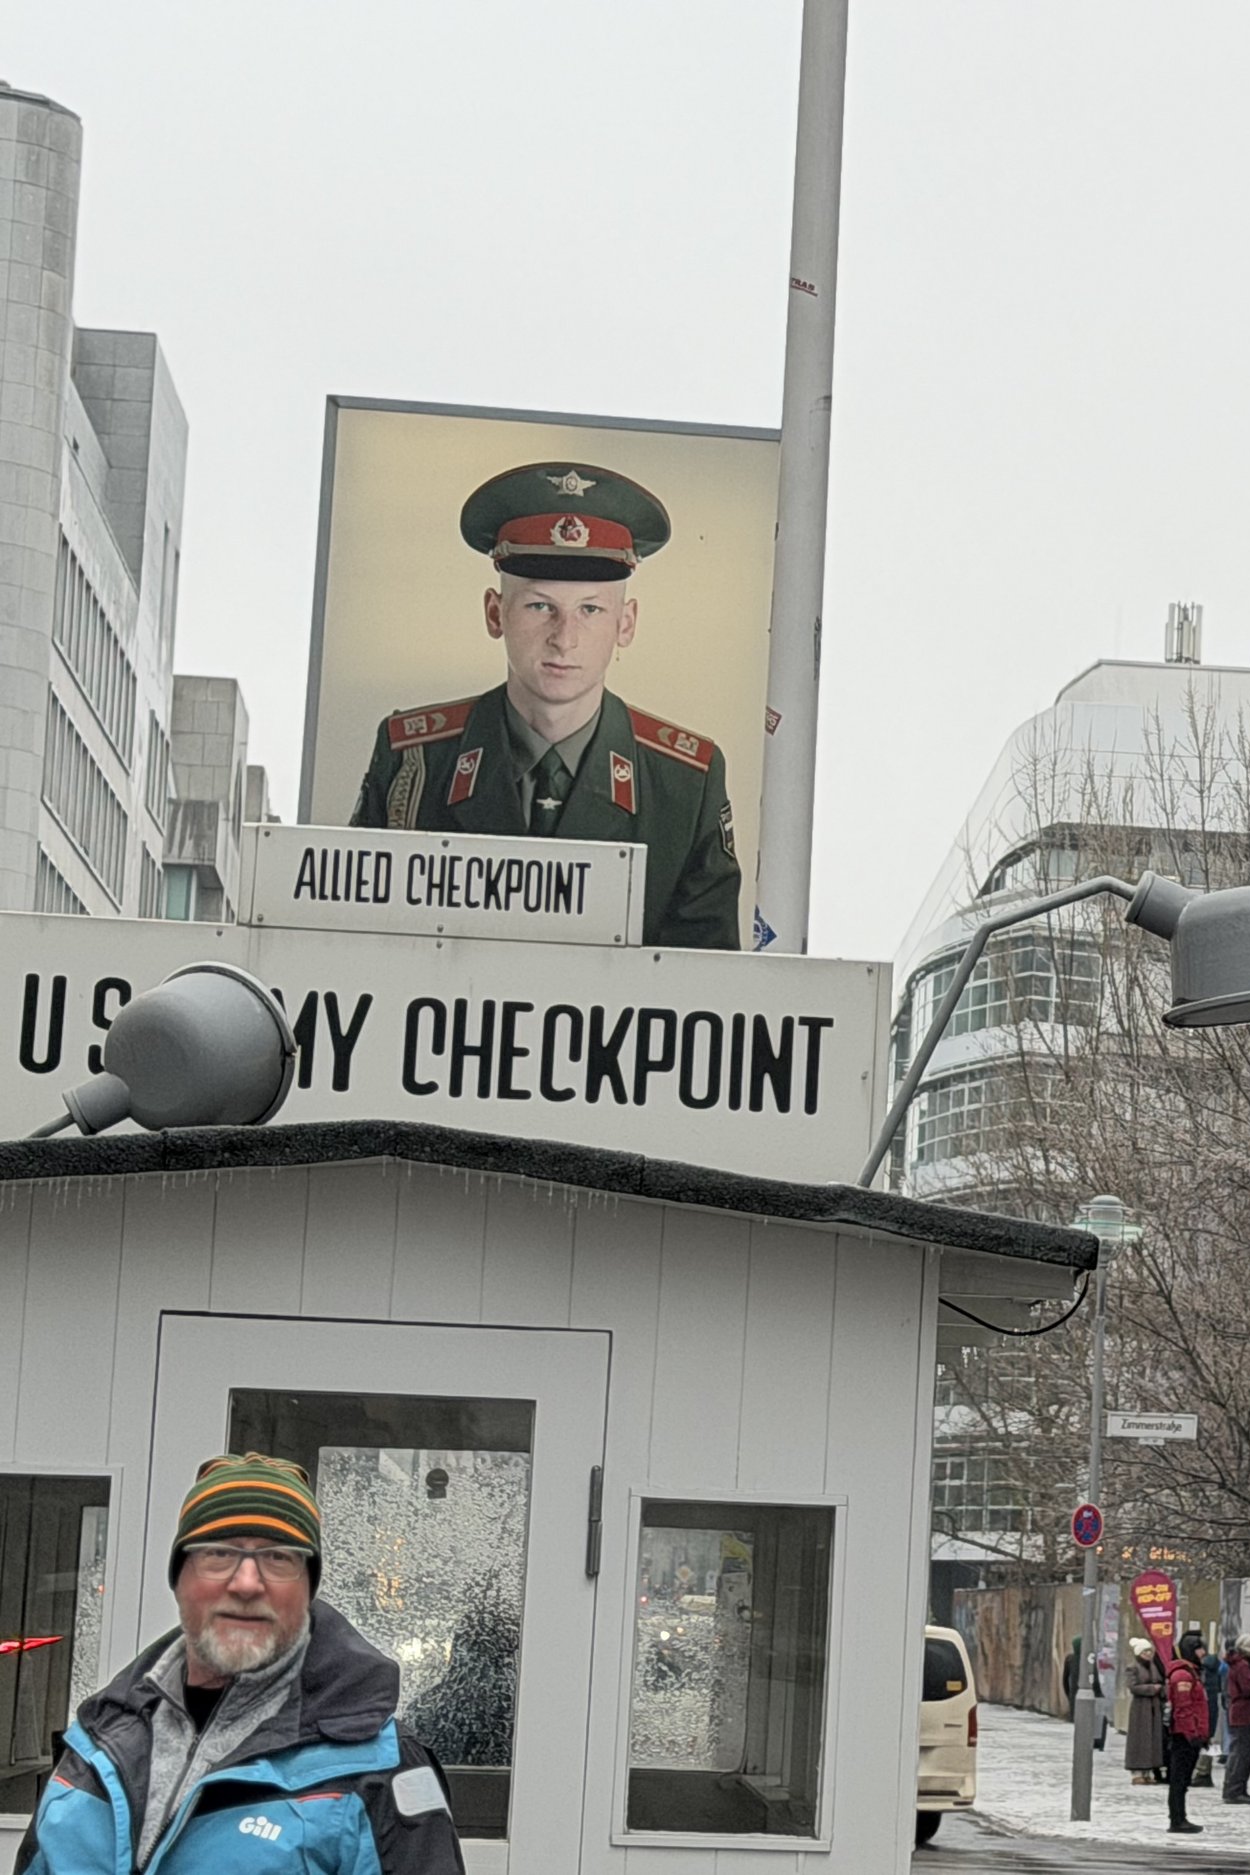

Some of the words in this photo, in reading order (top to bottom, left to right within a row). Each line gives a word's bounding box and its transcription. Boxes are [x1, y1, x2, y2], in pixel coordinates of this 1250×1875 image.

[294, 848, 392, 903] ALLIED
[407, 854, 591, 914] CHECKPOINT
[20, 974, 66, 1073] U
[403, 998, 833, 1114] CHECKPOINT
[239, 1816, 282, 1841] Gill
